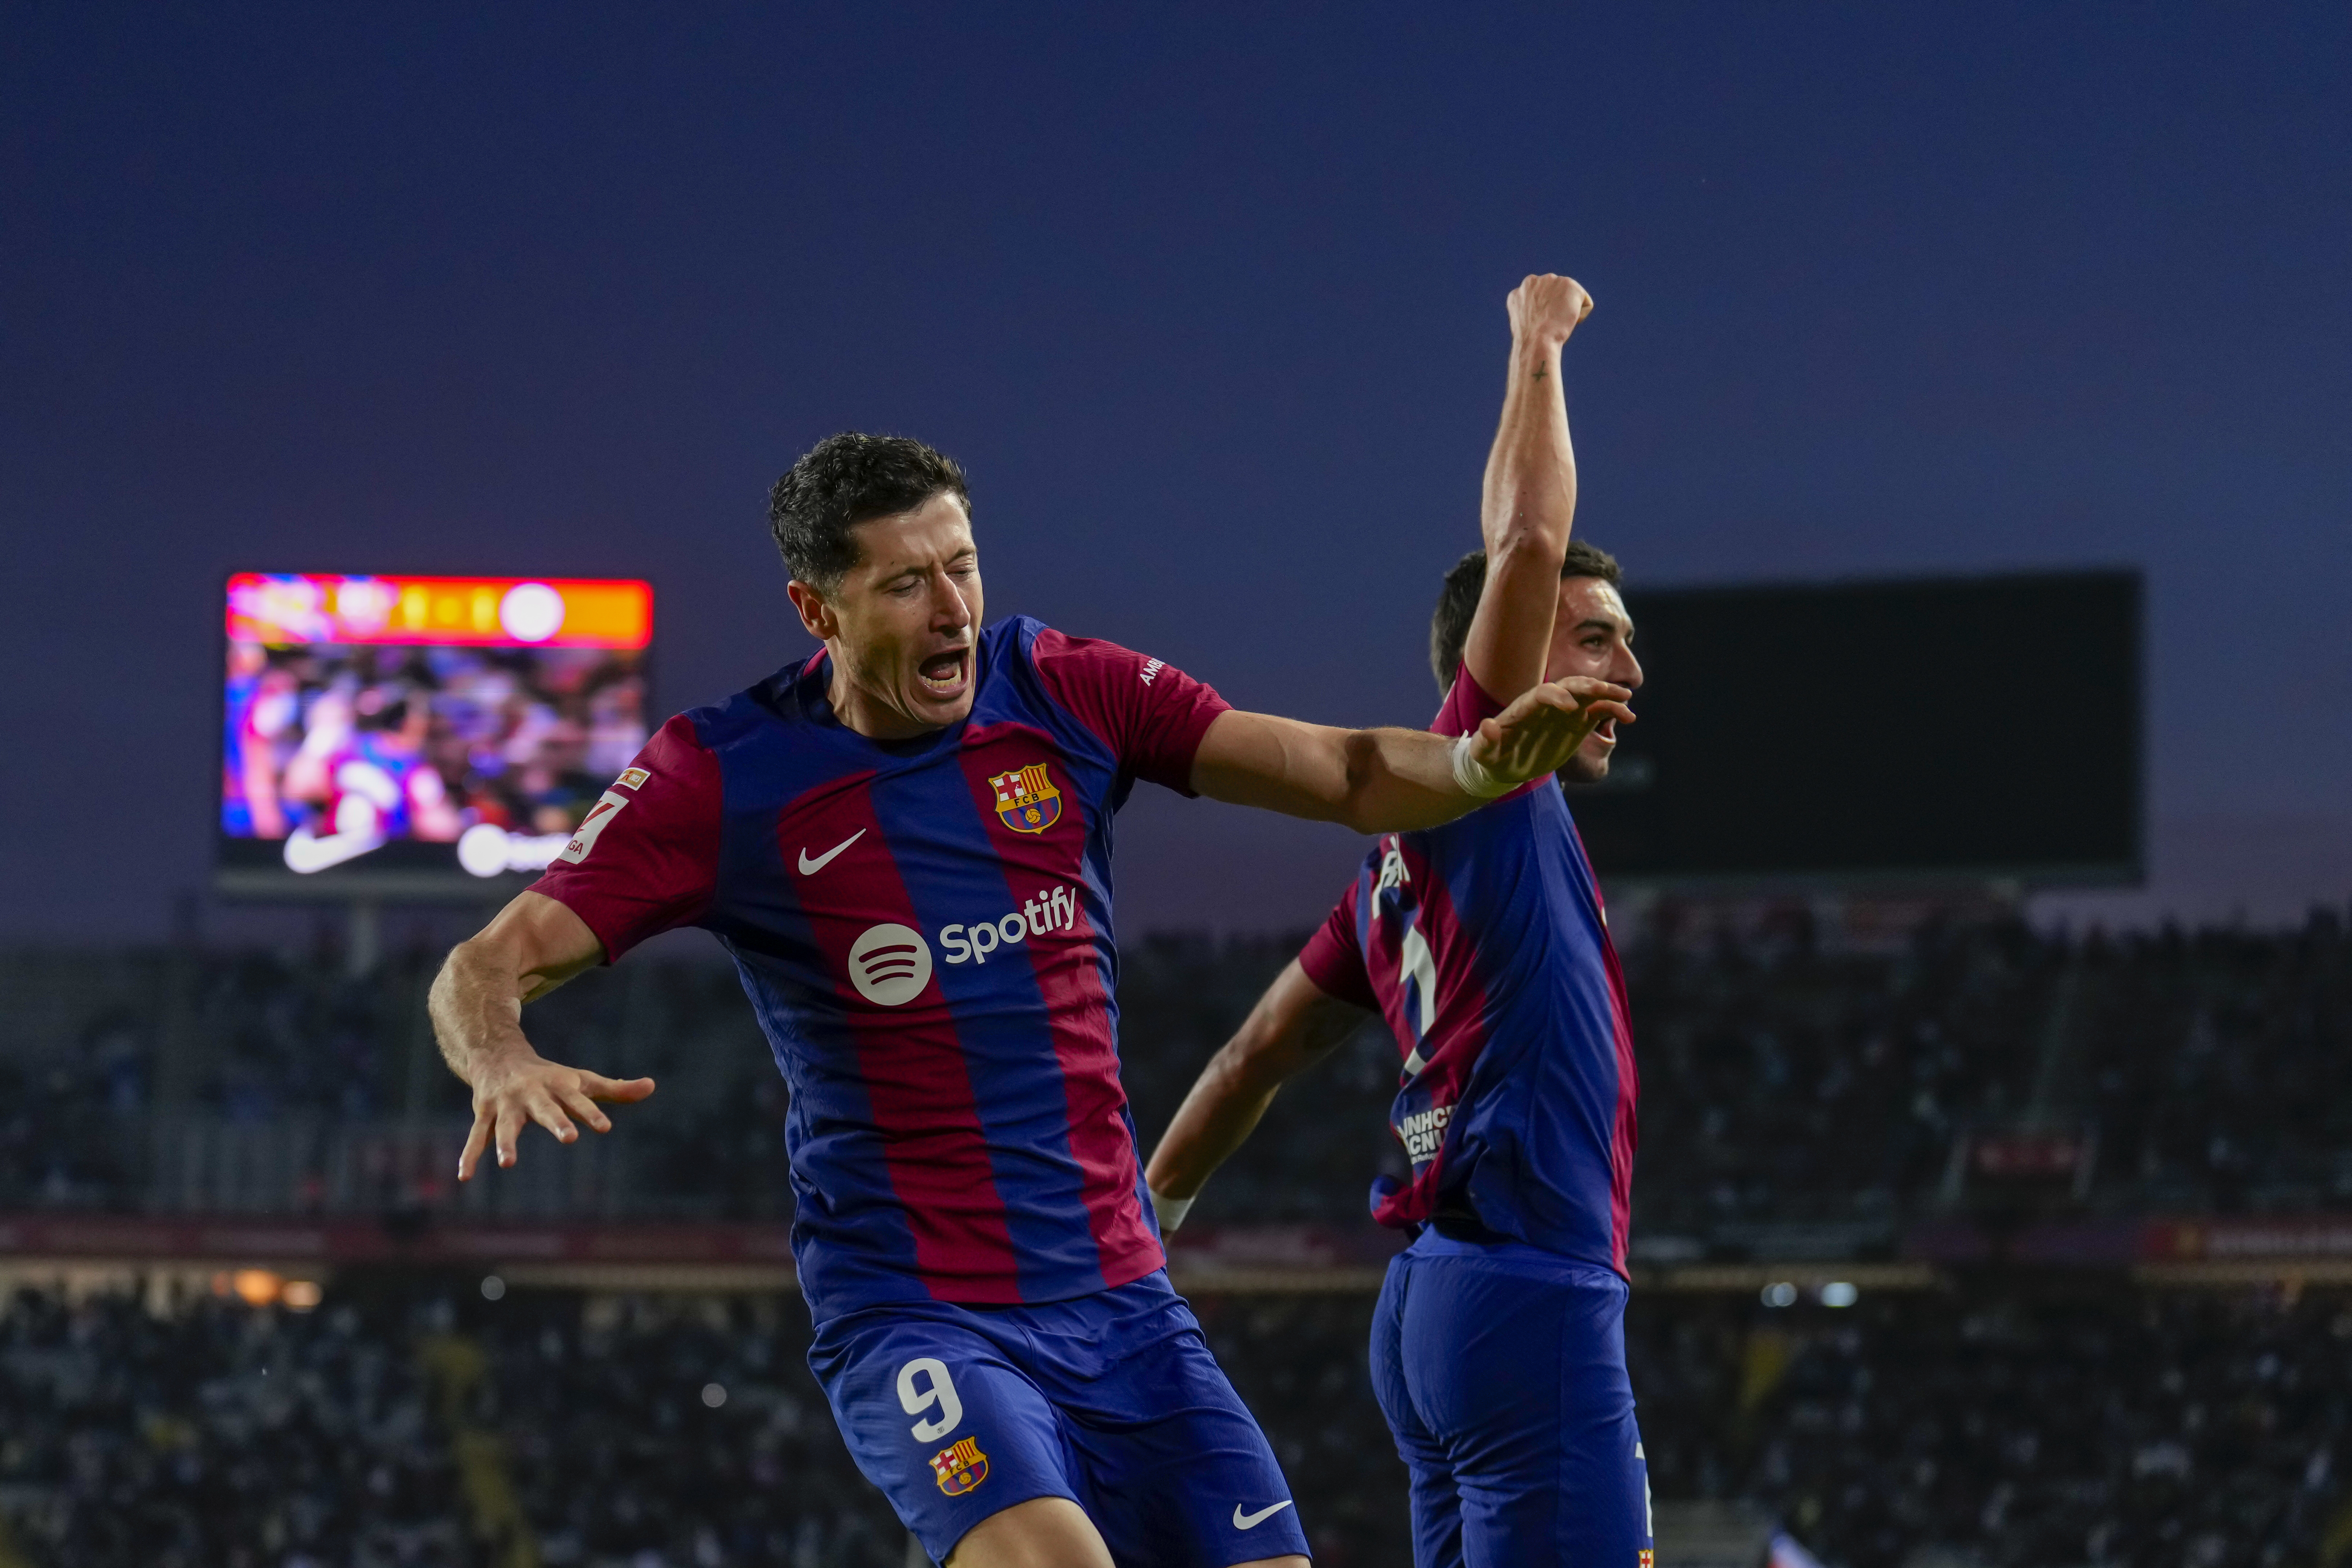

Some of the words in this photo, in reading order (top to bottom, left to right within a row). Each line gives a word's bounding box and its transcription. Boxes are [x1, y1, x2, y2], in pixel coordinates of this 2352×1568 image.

[1014, 793, 1039, 807] FCB
[939, 886, 1075, 964] Spotify
[897, 1358, 963, 1442] 9
[950, 1461, 969, 1475] FCB
